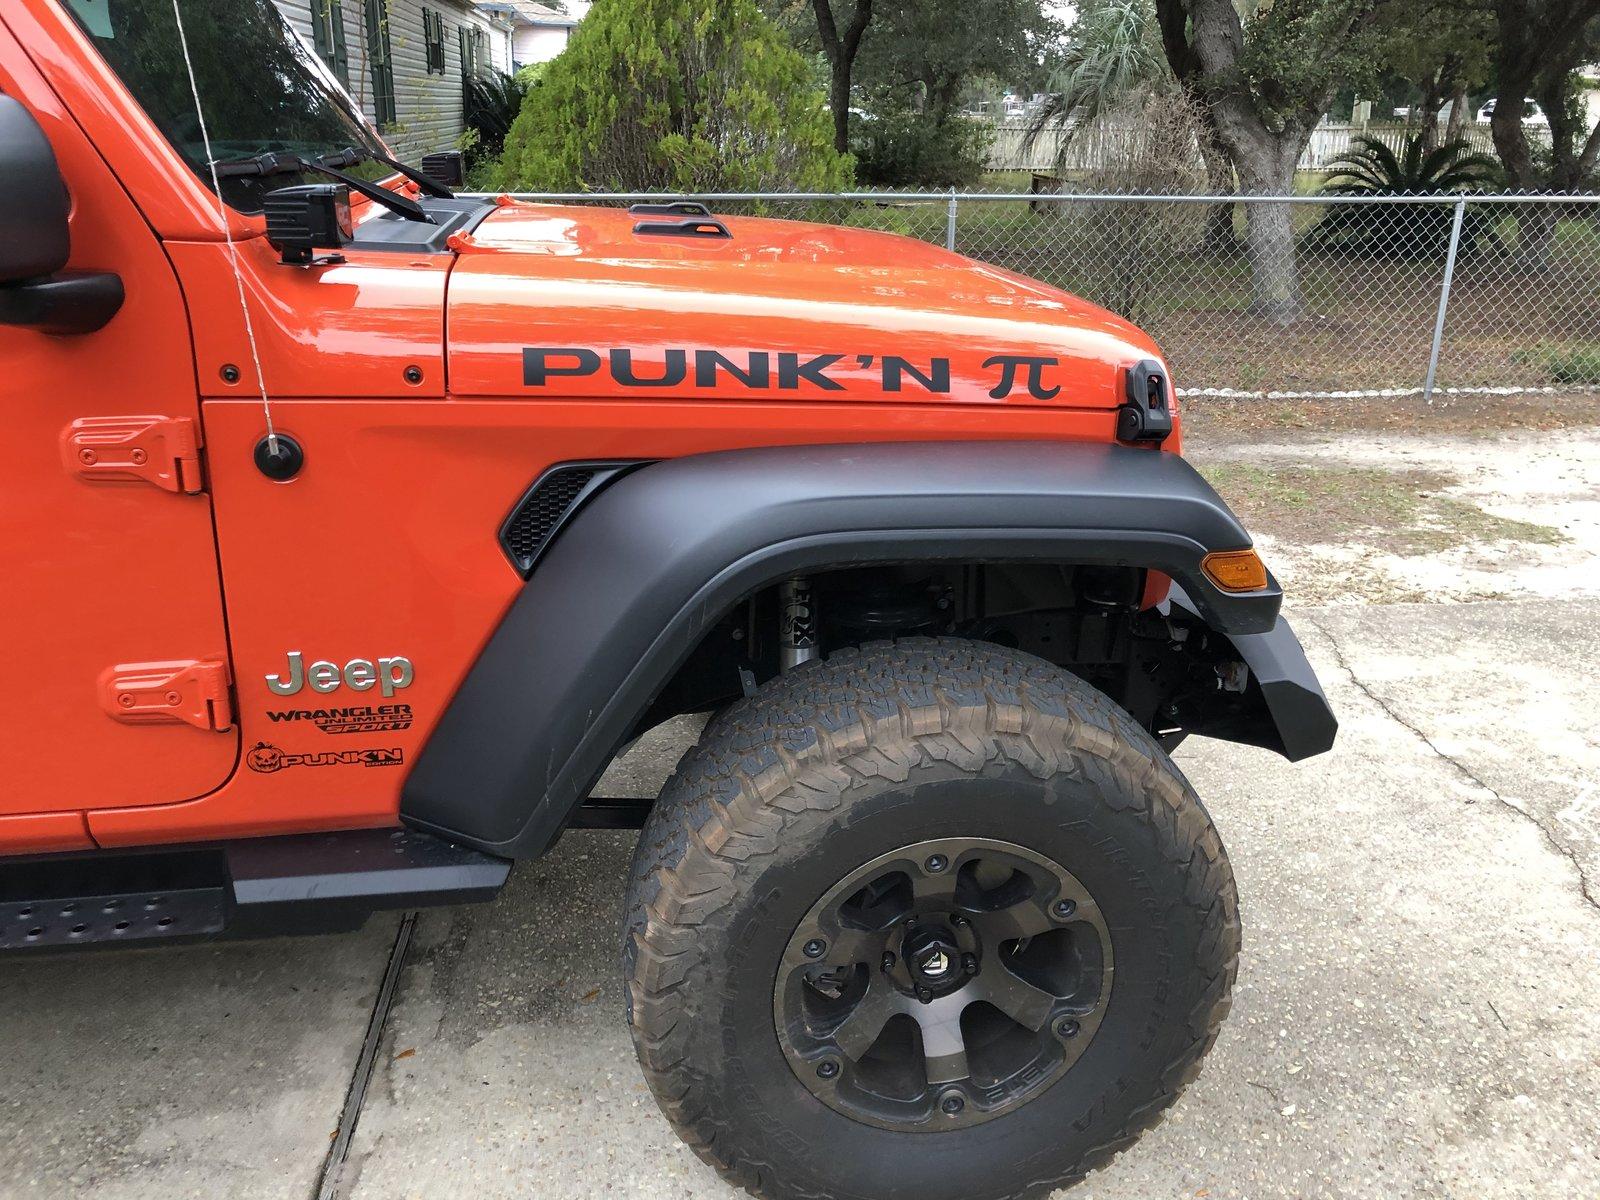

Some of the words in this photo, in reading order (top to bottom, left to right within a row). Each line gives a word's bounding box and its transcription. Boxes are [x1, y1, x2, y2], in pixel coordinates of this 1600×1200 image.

[522, 347, 951, 393] PUNK'N
[265, 650, 414, 698] Jeep
[266, 704, 412, 723] WRANGLER
[314, 714, 413, 725] UNLIMITED
[318, 722, 411, 734] SPORT
[278, 748, 404, 769] PUNK'N
